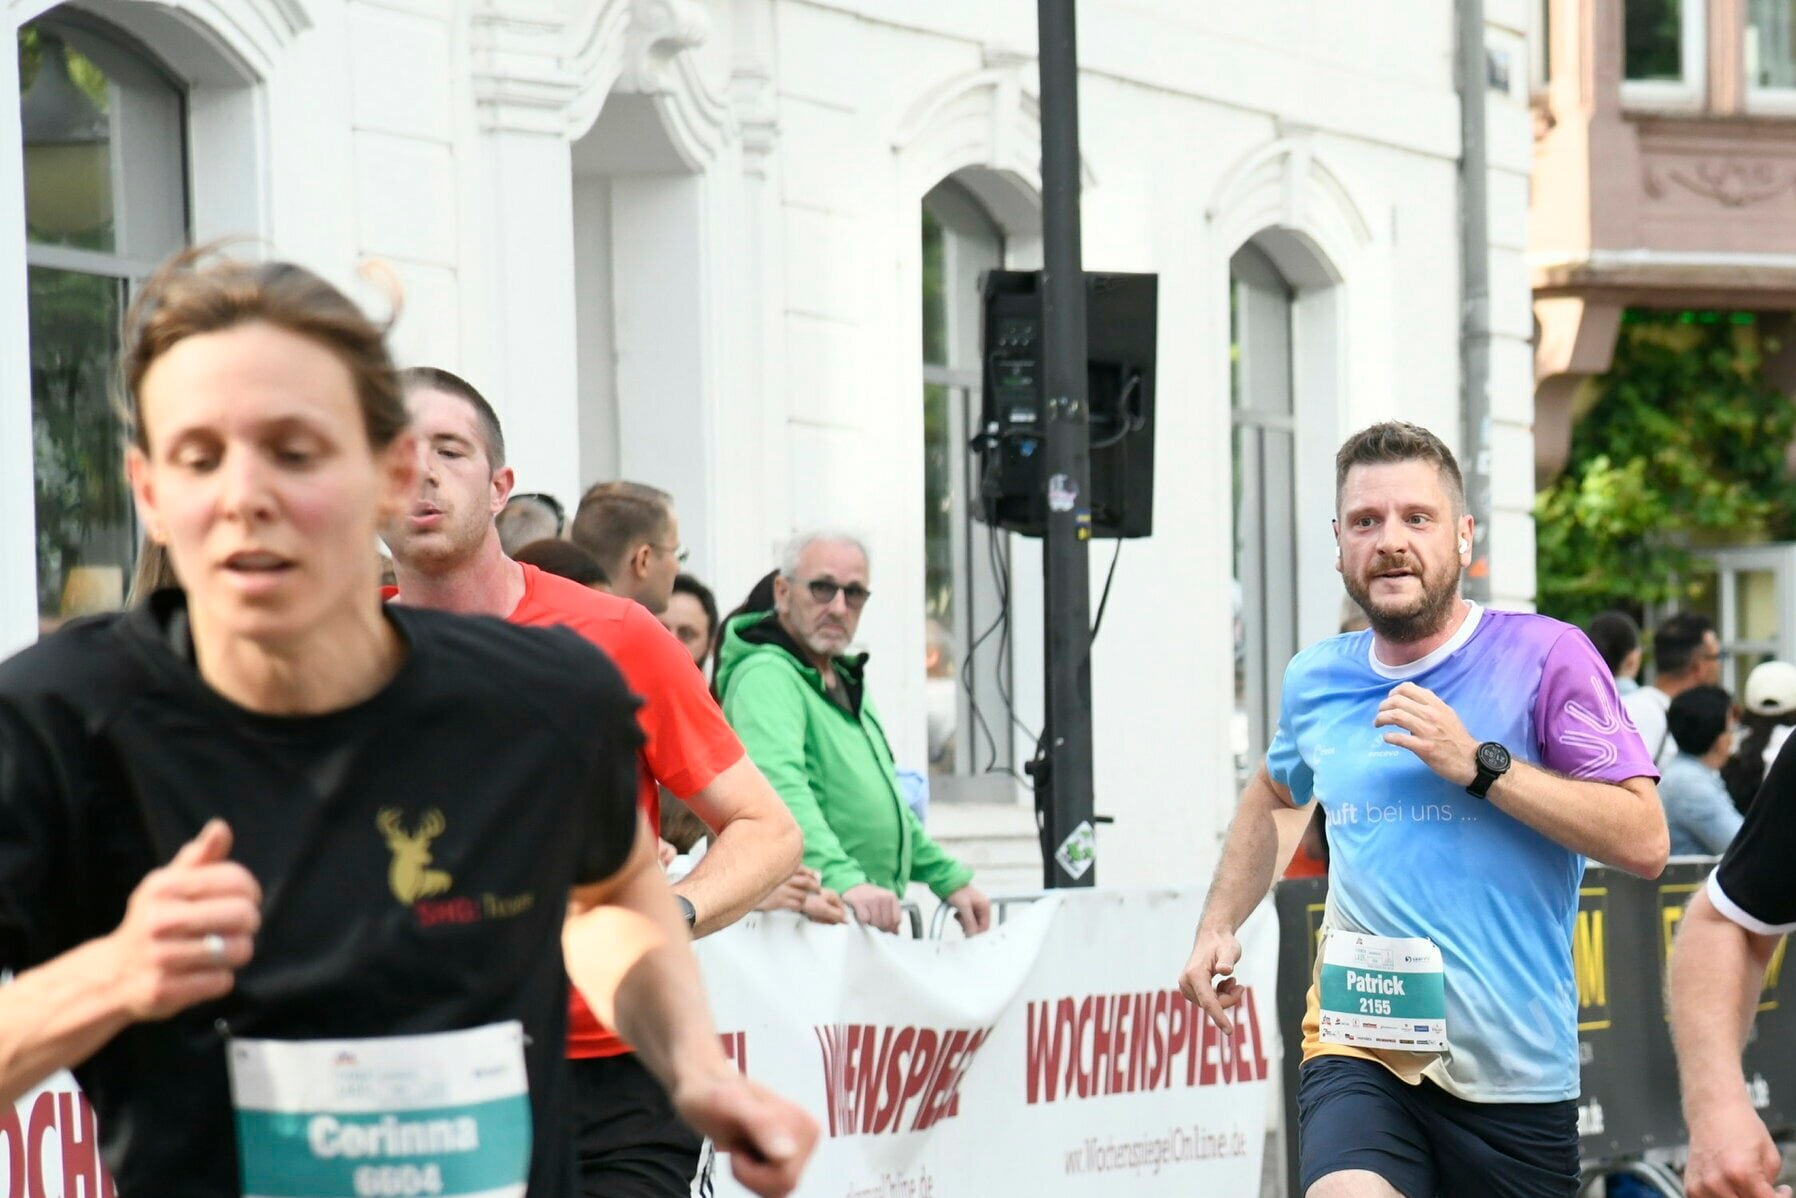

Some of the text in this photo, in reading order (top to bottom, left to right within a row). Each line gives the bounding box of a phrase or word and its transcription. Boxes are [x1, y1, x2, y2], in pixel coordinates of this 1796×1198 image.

[1366, 800, 1402, 823] bei
[1411, 804, 1453, 822] uns
[1346, 970, 1406, 996] Patrick
[1359, 997, 1392, 1015] 2155
[307, 1114, 479, 1159] Corinna
